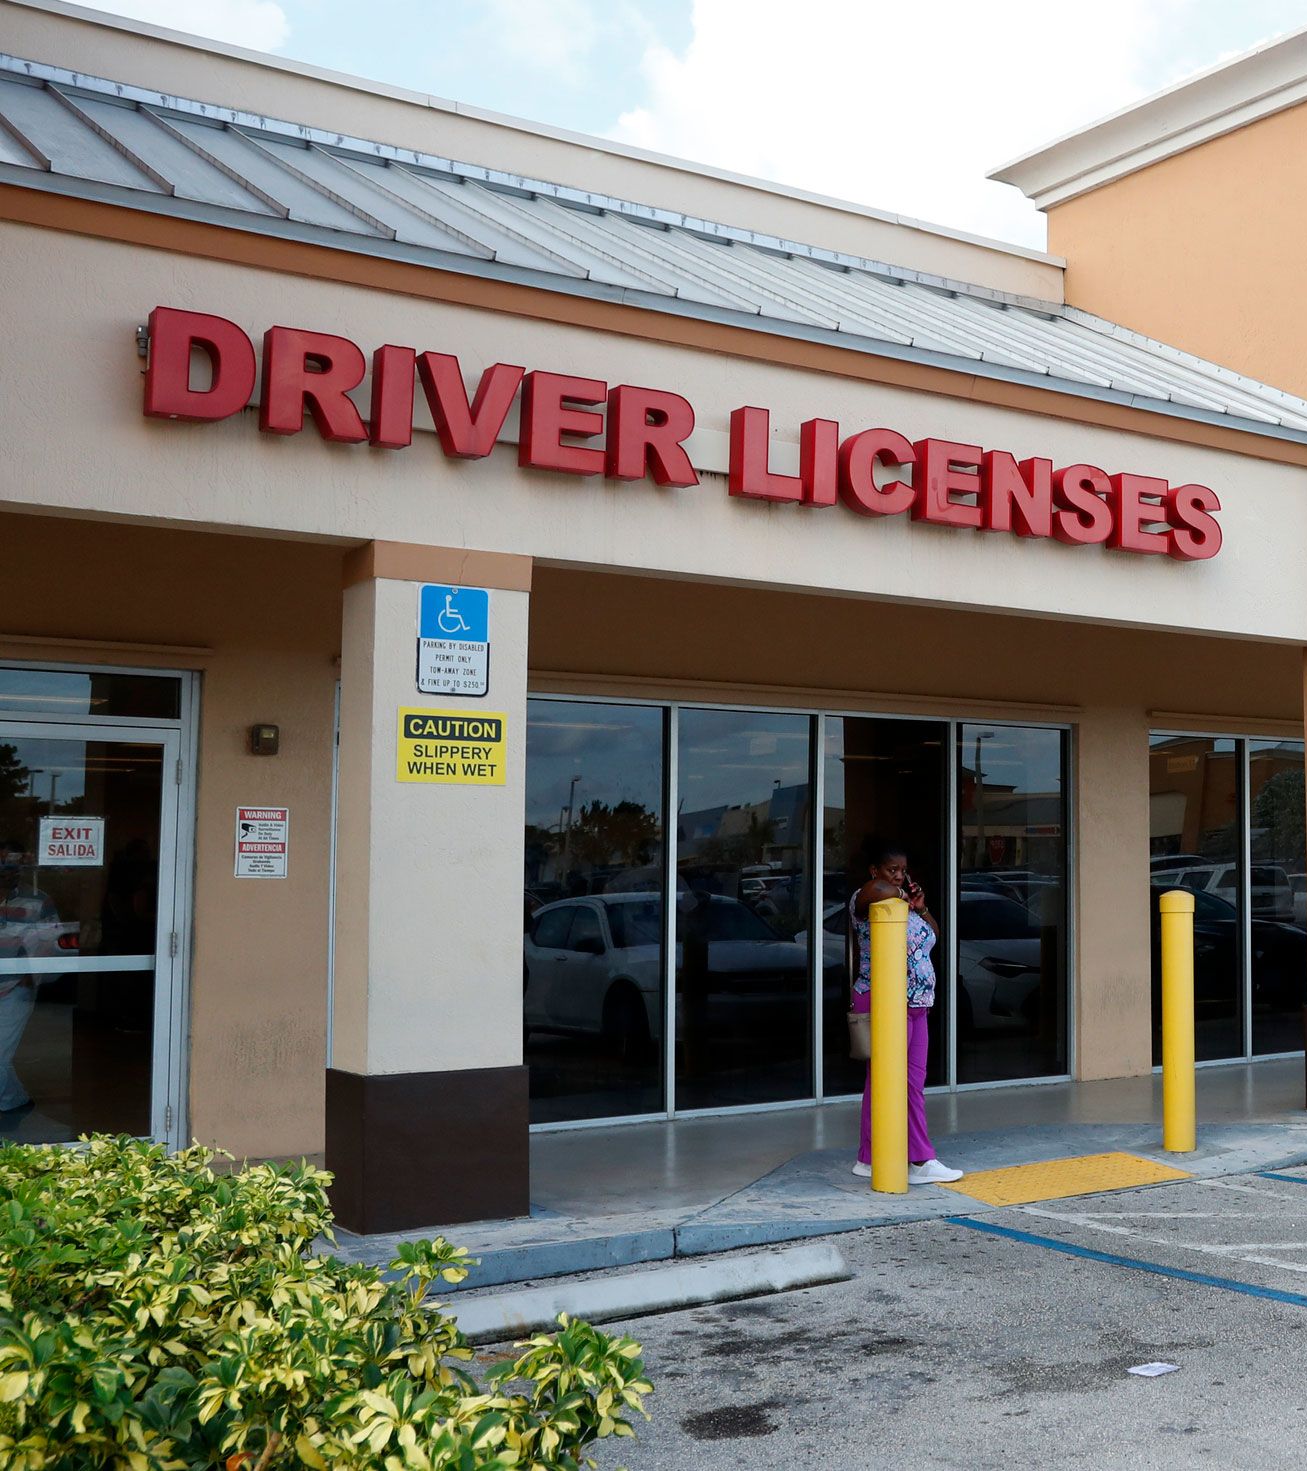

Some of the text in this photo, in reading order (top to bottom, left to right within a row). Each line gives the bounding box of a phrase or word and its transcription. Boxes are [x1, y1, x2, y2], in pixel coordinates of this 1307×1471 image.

[143, 305, 1223, 562] DRIVER LICENSES
[423, 640, 485, 652] PARKING BY DISABLED
[435, 654, 472, 664] PERMIT ONLY
[430, 666, 477, 676] TOW-AWAY ZONE
[427, 678, 440, 687] FINE
[442, 679, 451, 687] UP
[453, 680, 460, 688] TO
[409, 718, 496, 739] CAUTION
[413, 744, 493, 760] SLIPPERY
[407, 761, 497, 777] WHEN WET
[244, 810, 282, 820] WARNING
[51, 827, 93, 840] EXIT
[47, 844, 95, 857] SALIDA
[242, 843, 282, 852] ADVERTENCIA
